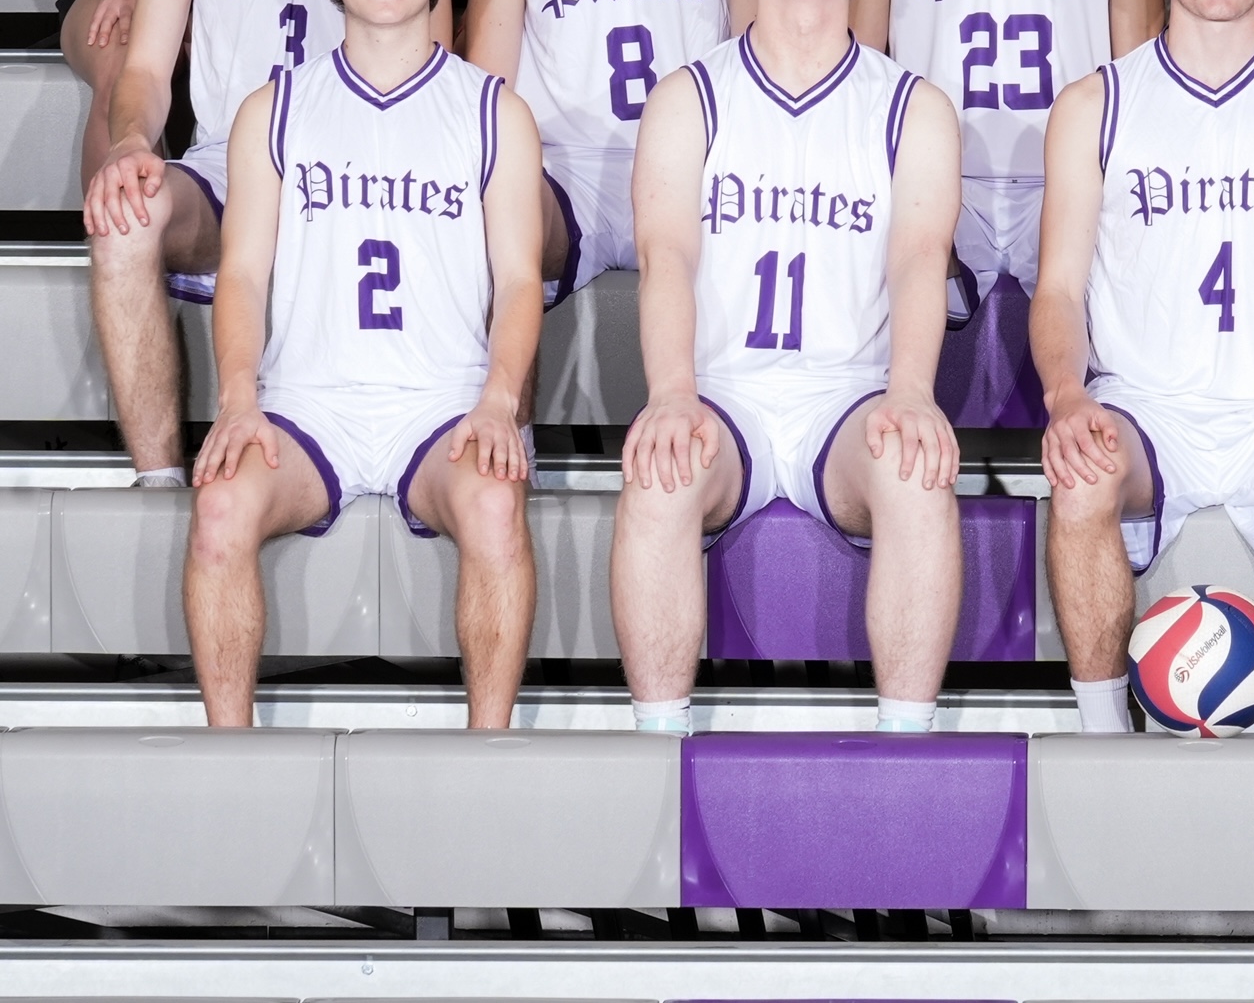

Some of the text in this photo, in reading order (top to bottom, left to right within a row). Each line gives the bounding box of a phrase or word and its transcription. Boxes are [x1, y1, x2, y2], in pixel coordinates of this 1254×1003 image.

[268, 3, 308, 83] 3
[606, 24, 658, 121] 8
[959, 12, 1054, 110] 23
[296, 161, 469, 222] Pirates
[701, 172, 876, 234] Pirates
[358, 239, 403, 331] 2
[745, 250, 806, 352] 11
[1198, 241, 1235, 332] 4
